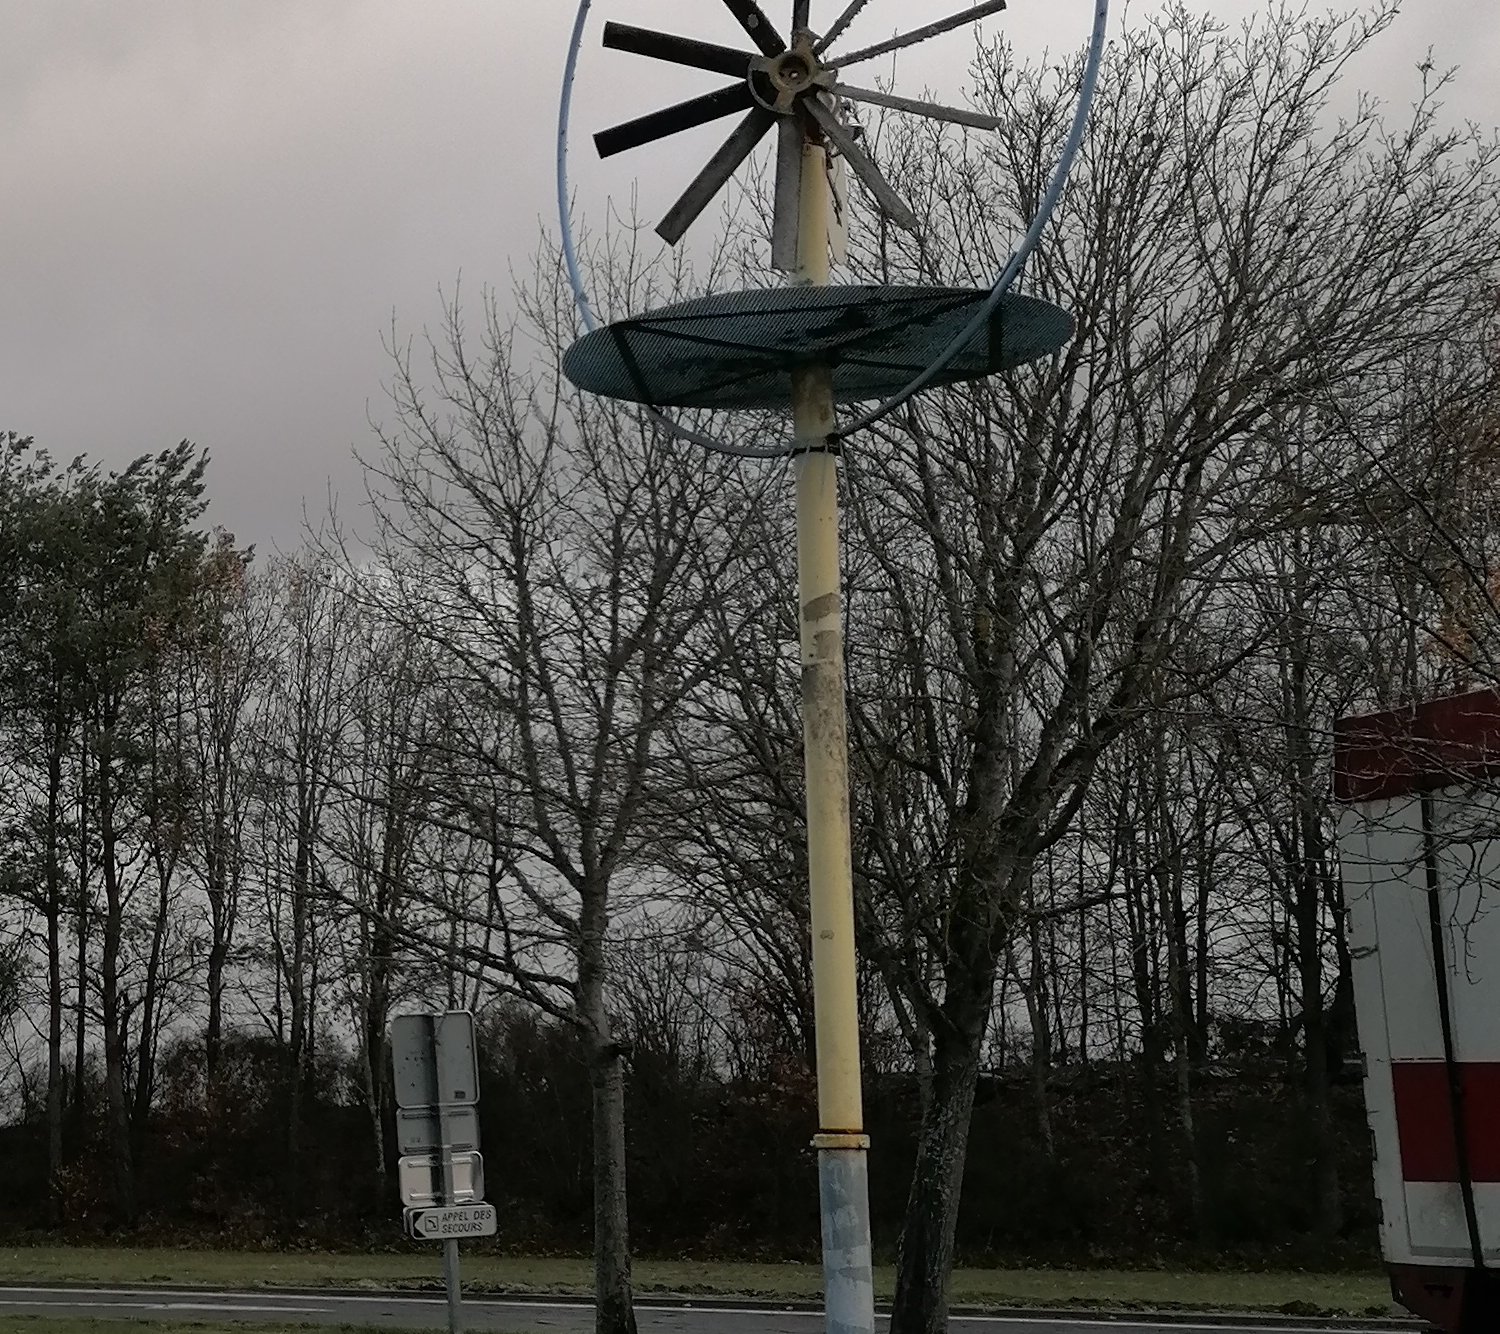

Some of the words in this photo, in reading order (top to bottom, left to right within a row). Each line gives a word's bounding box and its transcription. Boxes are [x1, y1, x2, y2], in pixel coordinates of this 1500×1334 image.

[441, 1211, 468, 1222] APPEL
[473, 1209, 492, 1220] DES
[441, 1222, 483, 1234] SECOURS
